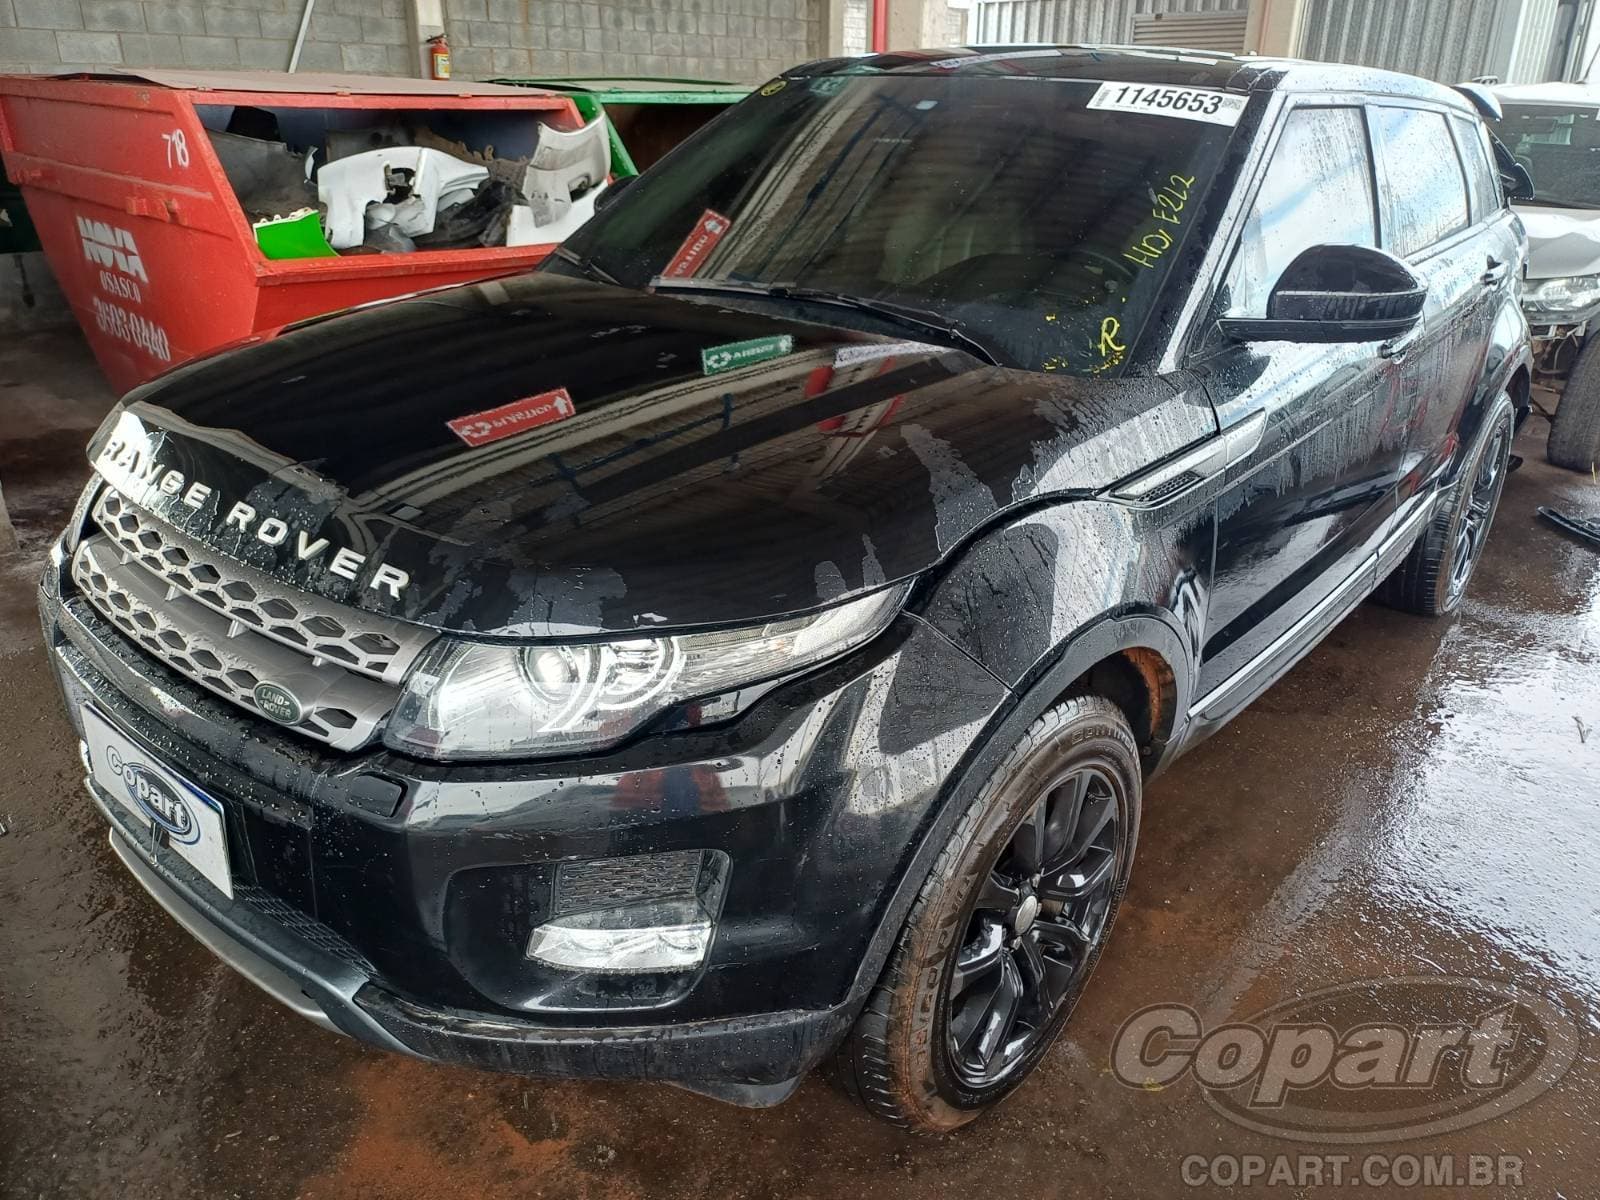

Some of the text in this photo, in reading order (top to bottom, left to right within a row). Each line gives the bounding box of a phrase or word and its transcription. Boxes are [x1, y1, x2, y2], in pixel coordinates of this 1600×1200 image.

[1115, 86, 1224, 115] 1145653
[99, 270, 141, 304] OSASCO
[103, 437, 410, 601] RANGE ROVER
[261, 688, 285, 706] LAND
[263, 699, 292, 719] ROVER
[106, 744, 187, 830] Copart
